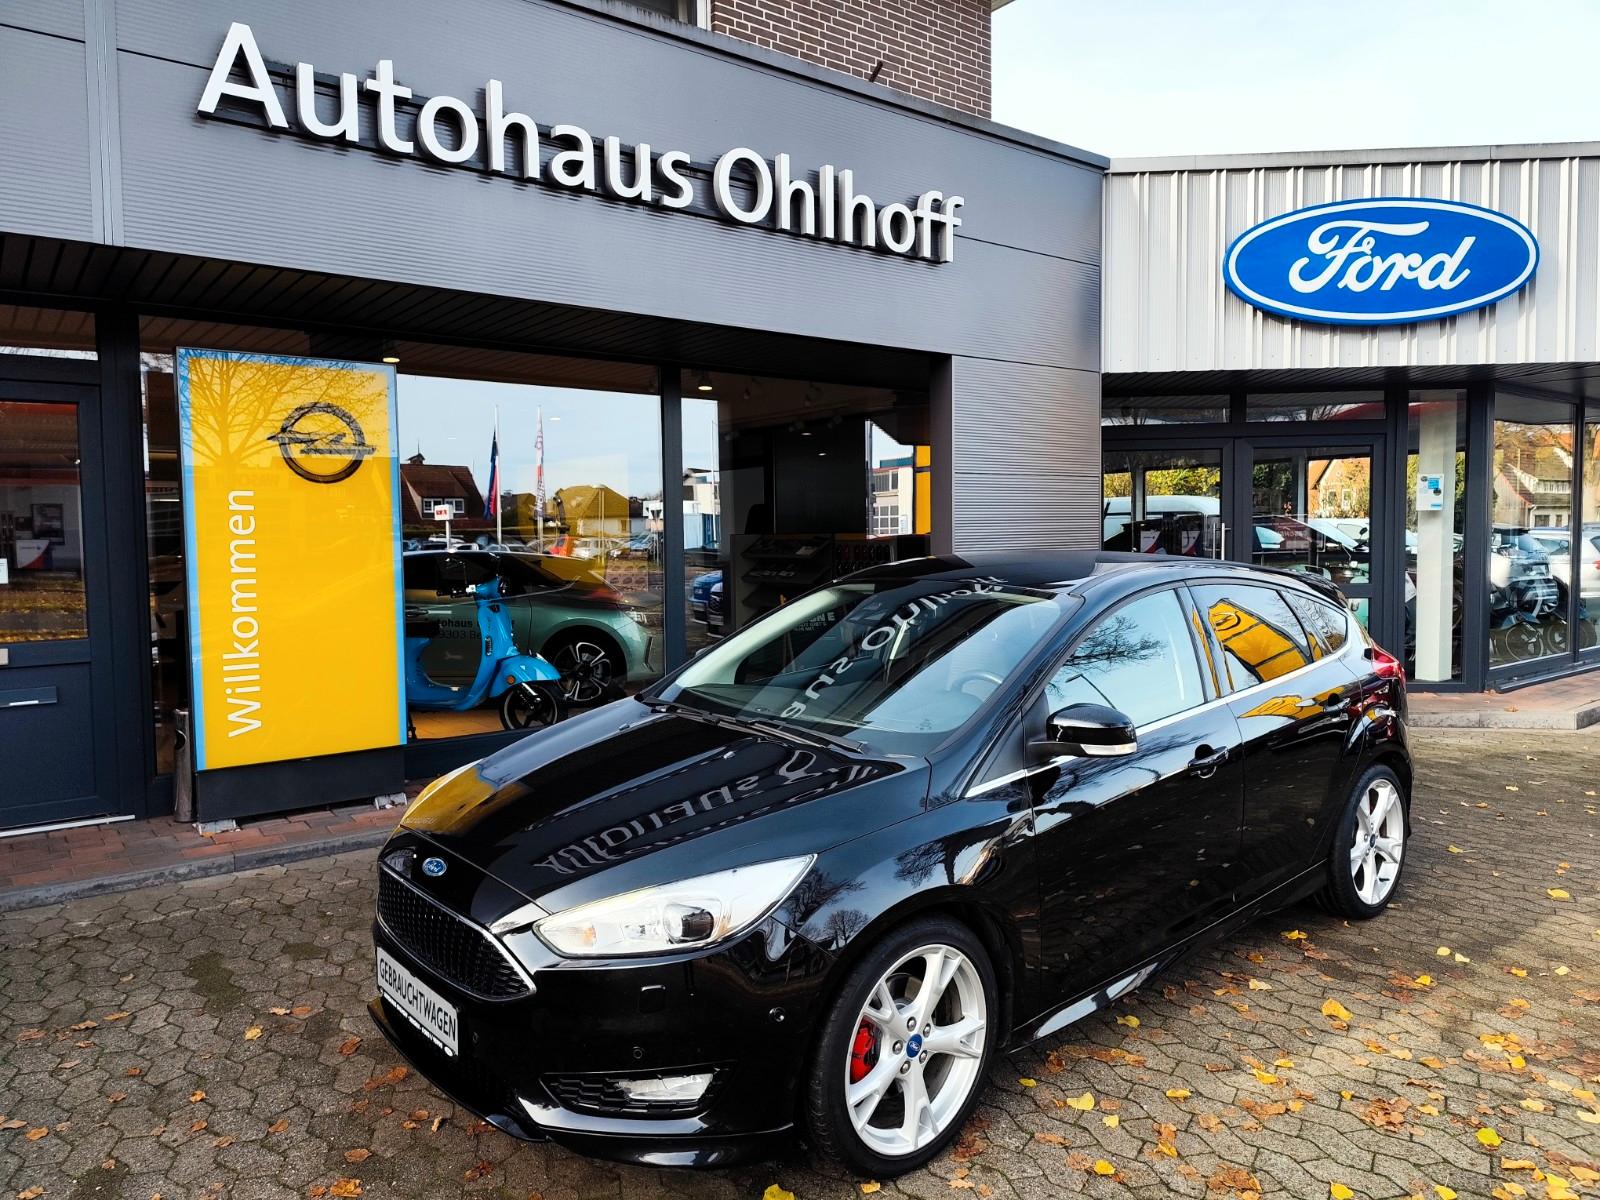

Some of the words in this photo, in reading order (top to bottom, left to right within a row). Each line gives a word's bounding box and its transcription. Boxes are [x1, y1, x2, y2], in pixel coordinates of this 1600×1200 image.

[196, 22, 694, 209] Autohaus
[713, 147, 965, 262] Ohlhoff
[1288, 220, 1476, 292] Ford
[223, 489, 262, 738] Willkommen
[434, 618, 472, 628] tohaus
[380, 958, 456, 1041] GEBRAUCHTWAGEN
